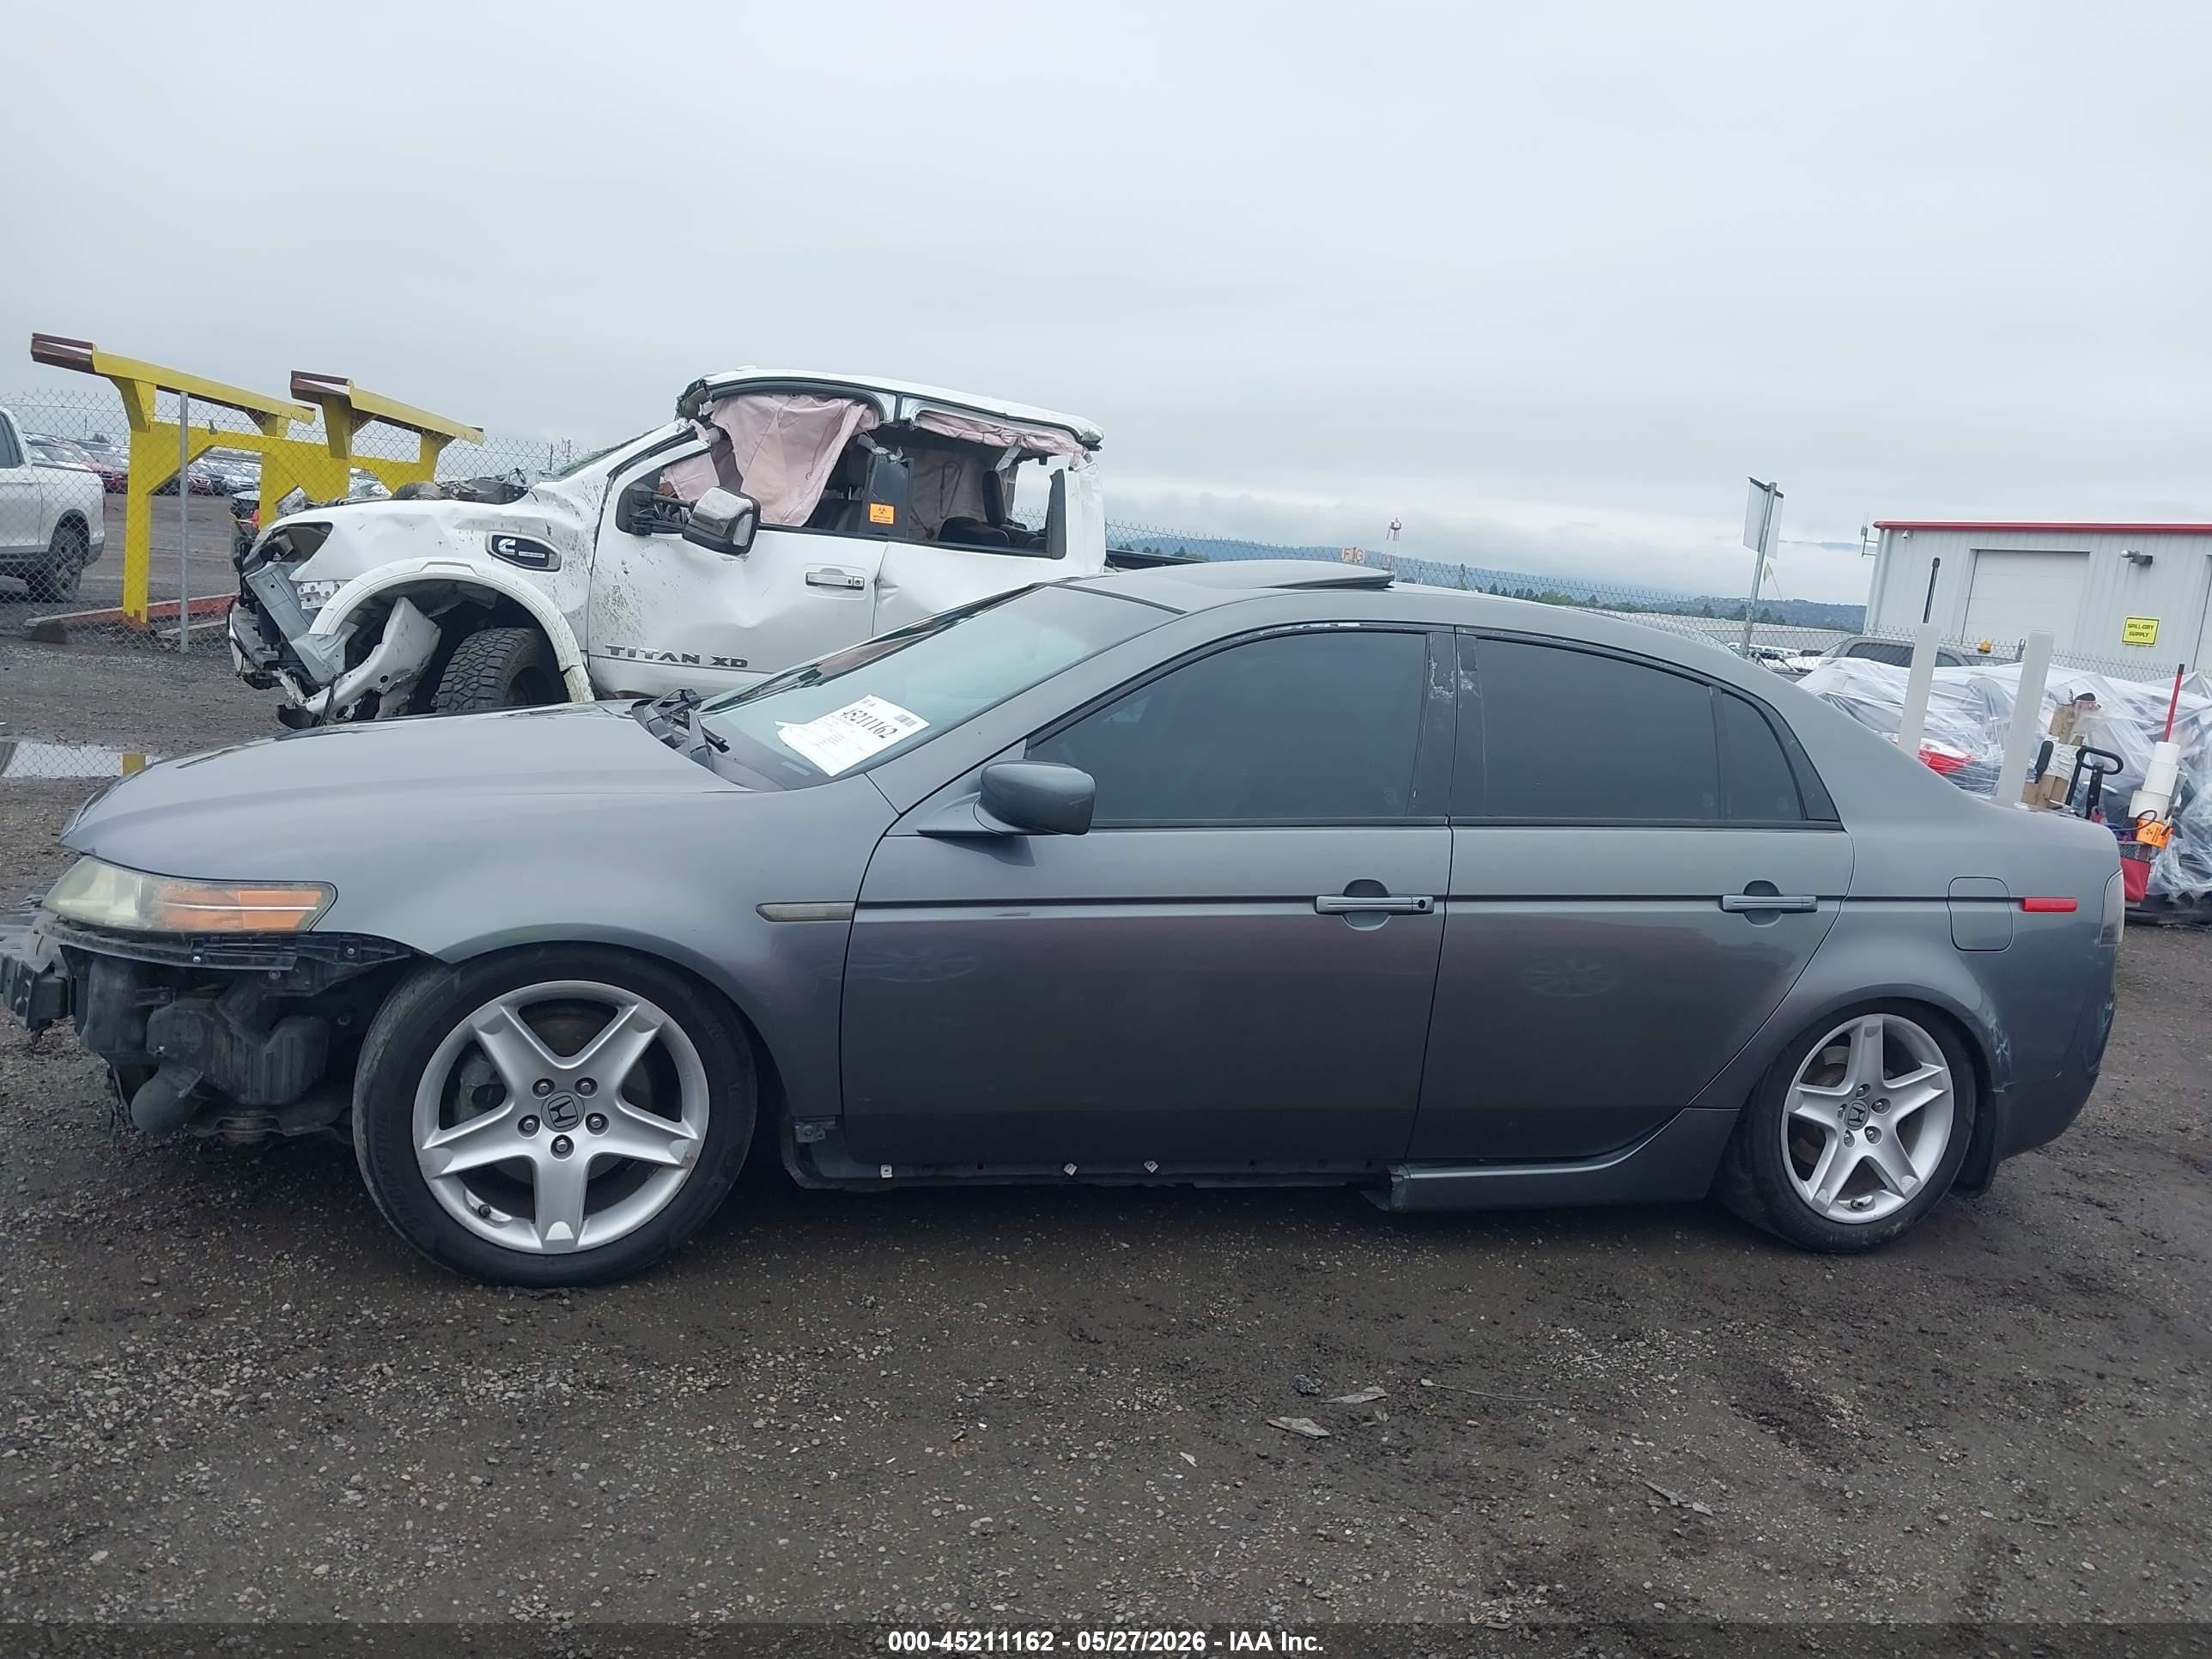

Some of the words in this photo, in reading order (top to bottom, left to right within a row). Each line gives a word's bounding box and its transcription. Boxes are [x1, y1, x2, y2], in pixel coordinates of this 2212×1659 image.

[605, 644, 701, 665] TITAN
[709, 655, 749, 668] XD
[841, 708, 898, 738] 45211162
